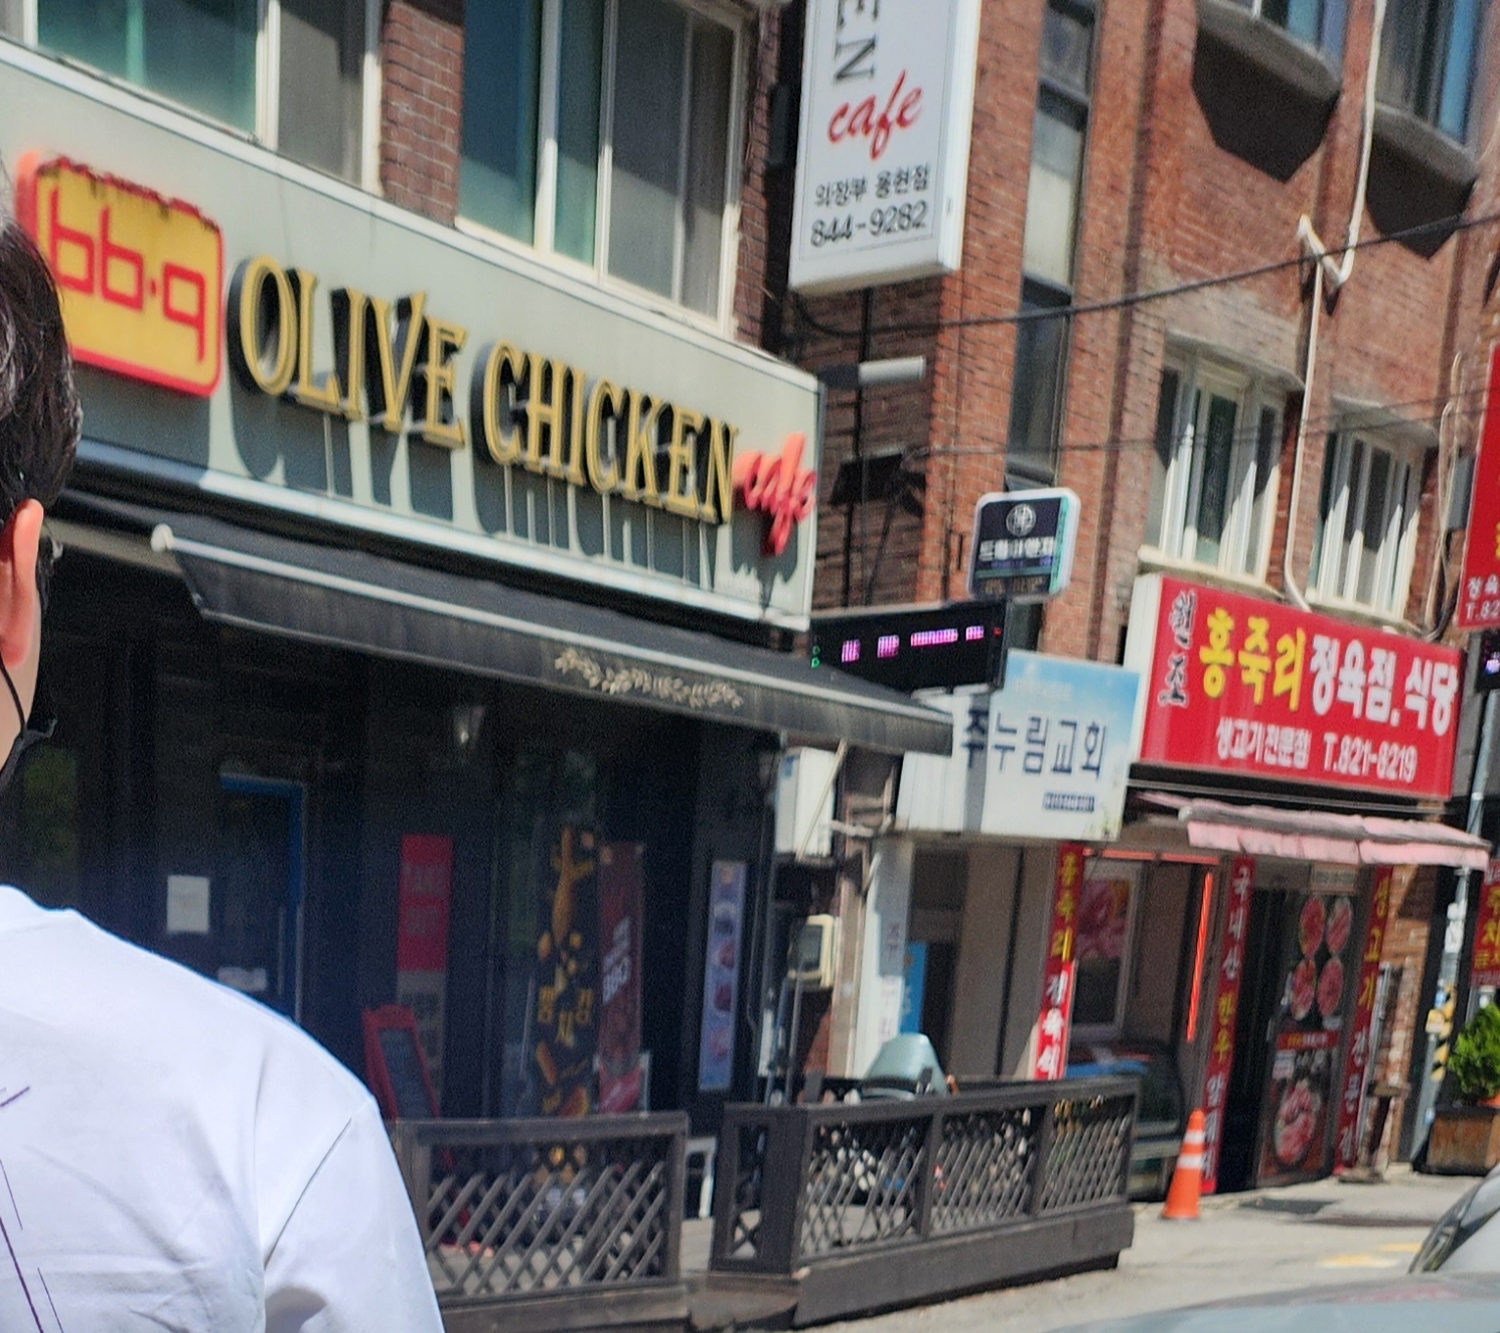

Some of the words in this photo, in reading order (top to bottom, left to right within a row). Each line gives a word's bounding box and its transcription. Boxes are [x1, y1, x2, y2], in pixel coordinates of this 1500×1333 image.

[827, 68, 924, 160] cafe
[230, 254, 468, 450] OLIVE
[475, 338, 739, 525] CHICKEN
